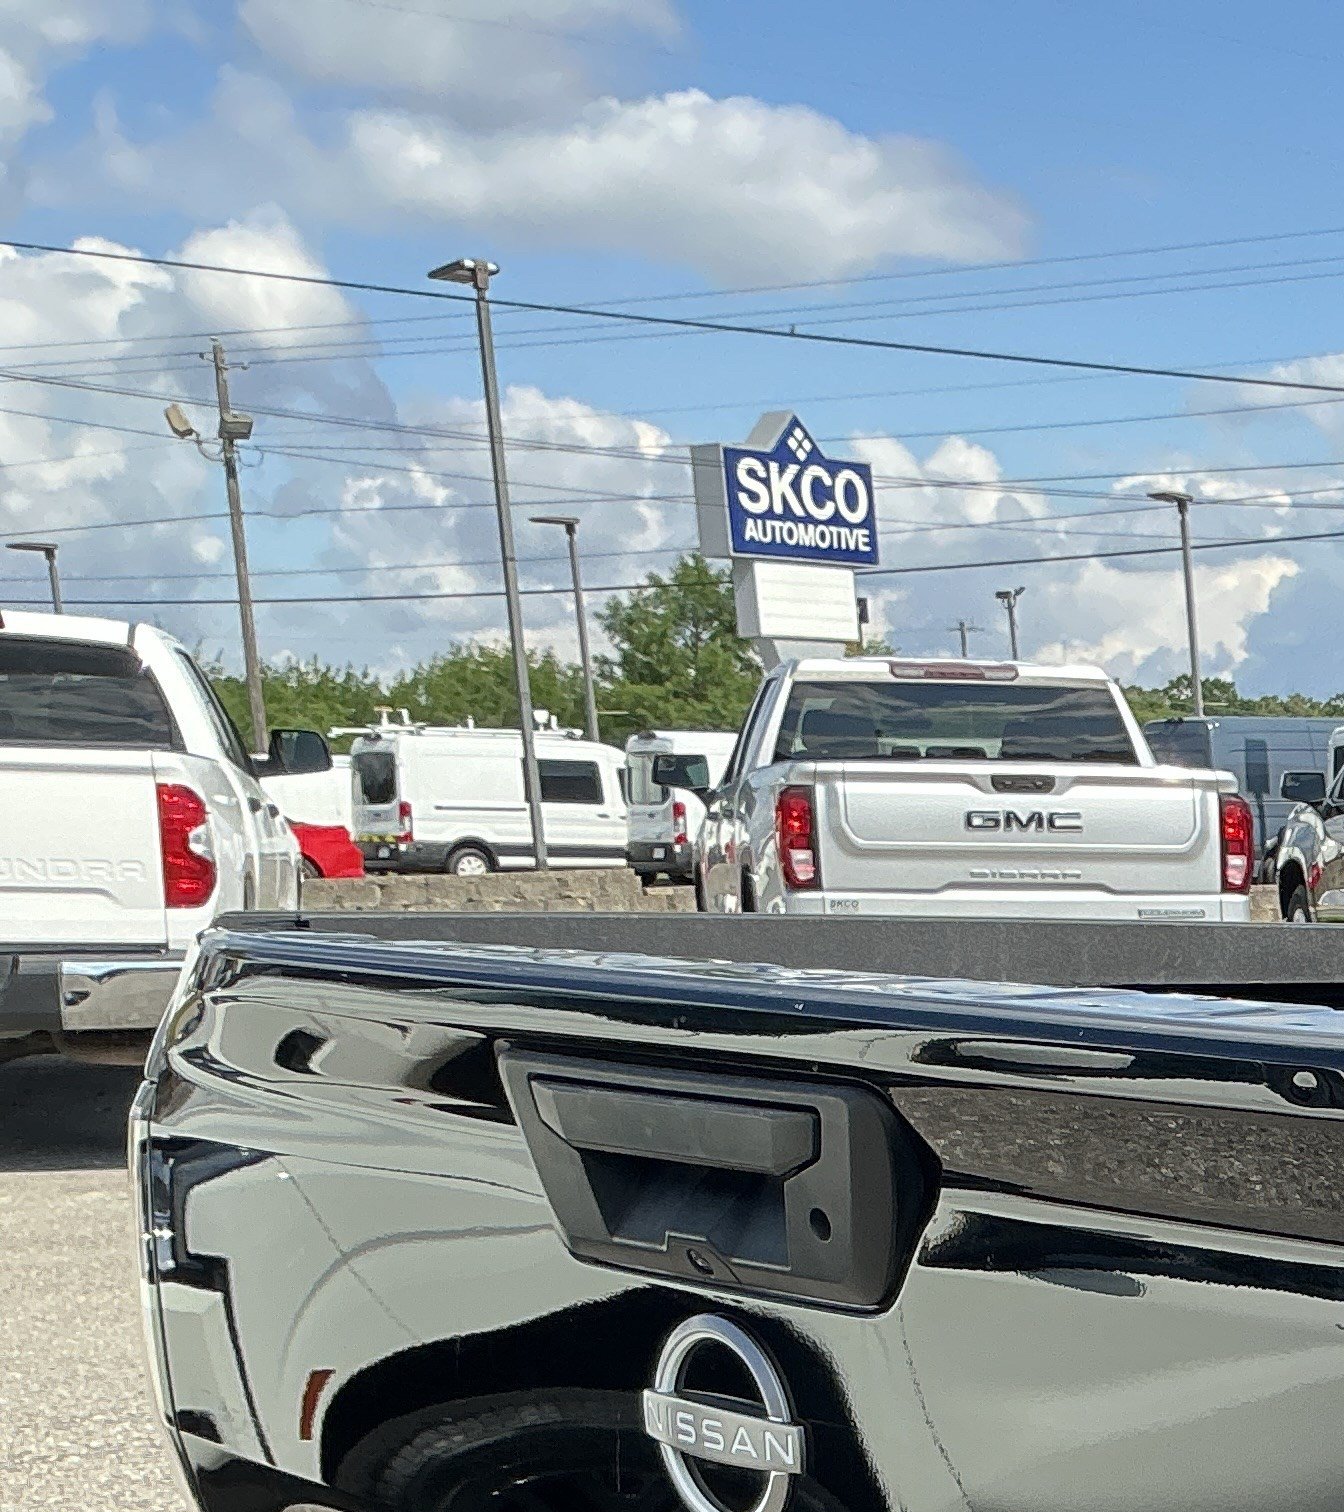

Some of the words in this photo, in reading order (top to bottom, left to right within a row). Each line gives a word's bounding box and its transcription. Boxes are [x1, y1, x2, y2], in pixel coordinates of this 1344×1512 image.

[737, 457, 869, 523] SKCO
[744, 518, 872, 551] AUTOMOTIVE
[966, 811, 1083, 833] GMC
[648, 1400, 795, 1467] NISSAN
